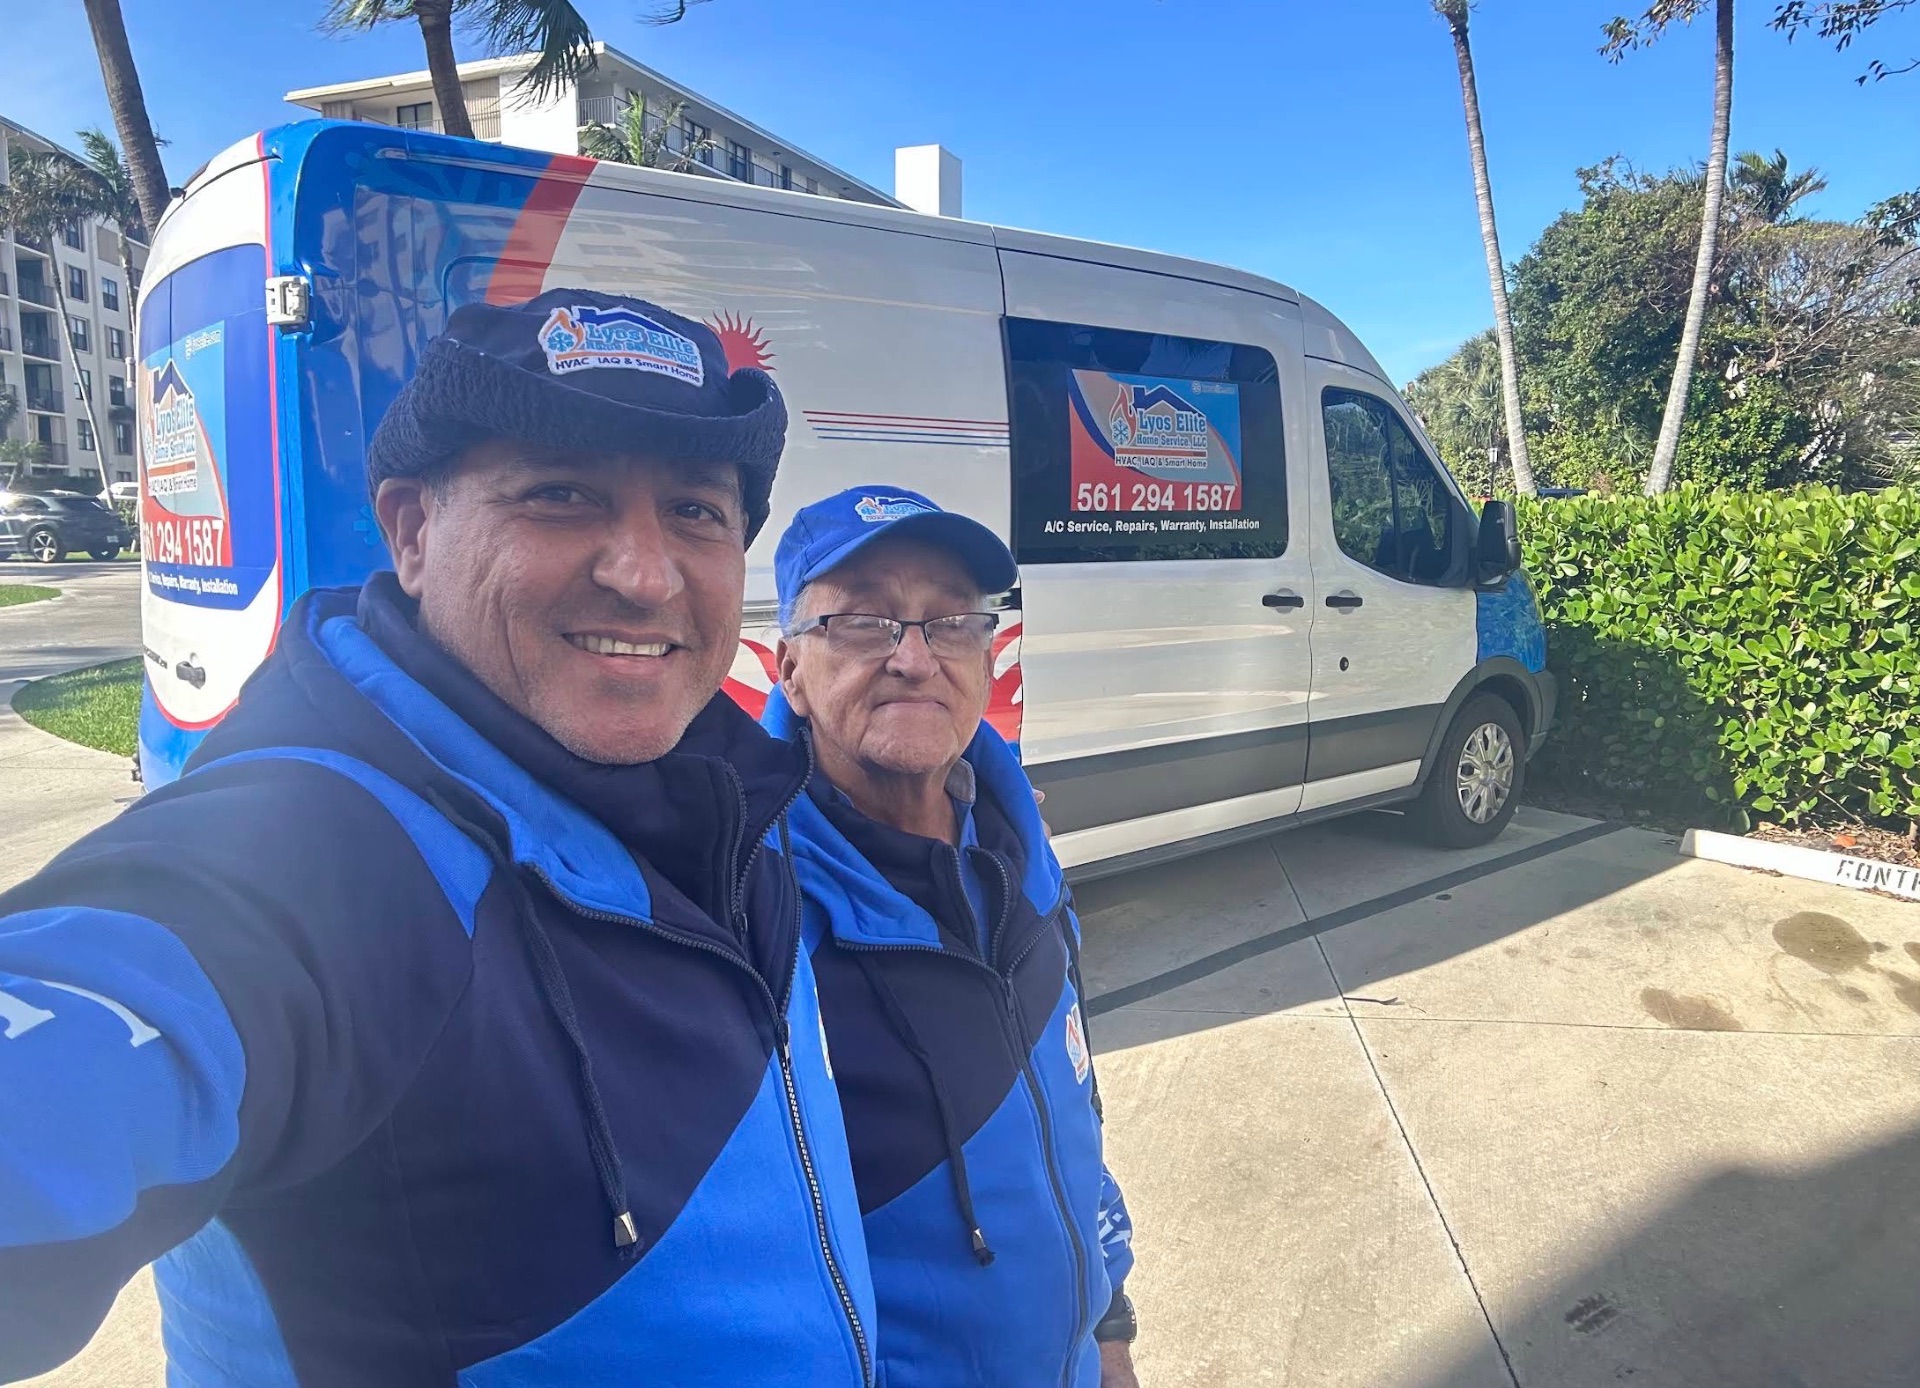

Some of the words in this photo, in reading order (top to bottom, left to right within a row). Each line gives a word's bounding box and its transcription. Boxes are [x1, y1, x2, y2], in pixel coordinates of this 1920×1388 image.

[587, 323, 642, 344] Lyos
[648, 331, 695, 355] Elite
[598, 356, 621, 365] IAQ
[624, 357, 633, 365] &
[636, 359, 669, 372] Smart
[671, 368, 700, 382] Home
[1138, 410, 1172, 434] Lyos
[1175, 413, 1206, 433] Elite
[1136, 434, 1159, 446] Home
[1193, 436, 1207, 448] LLC
[1115, 456, 1140, 467] HVAC,
[1142, 457, 1156, 466] IAQ
[1158, 458, 1163, 466] &
[1165, 458, 1185, 467] Smart
[1187, 459, 1207, 468] Home
[1077, 482, 1121, 512] 561
[1131, 483, 1174, 512] 294
[1184, 484, 1236, 511] 1587
[1044, 520, 1064, 533] A/C
[1067, 520, 1113, 534] Service,
[1115, 520, 1158, 534] Repairs,
[1160, 519, 1207, 533] Warranty,
[1209, 518, 1260, 530] Installation
[157, 520, 182, 565] 294
[184, 518, 224, 567] 1587
